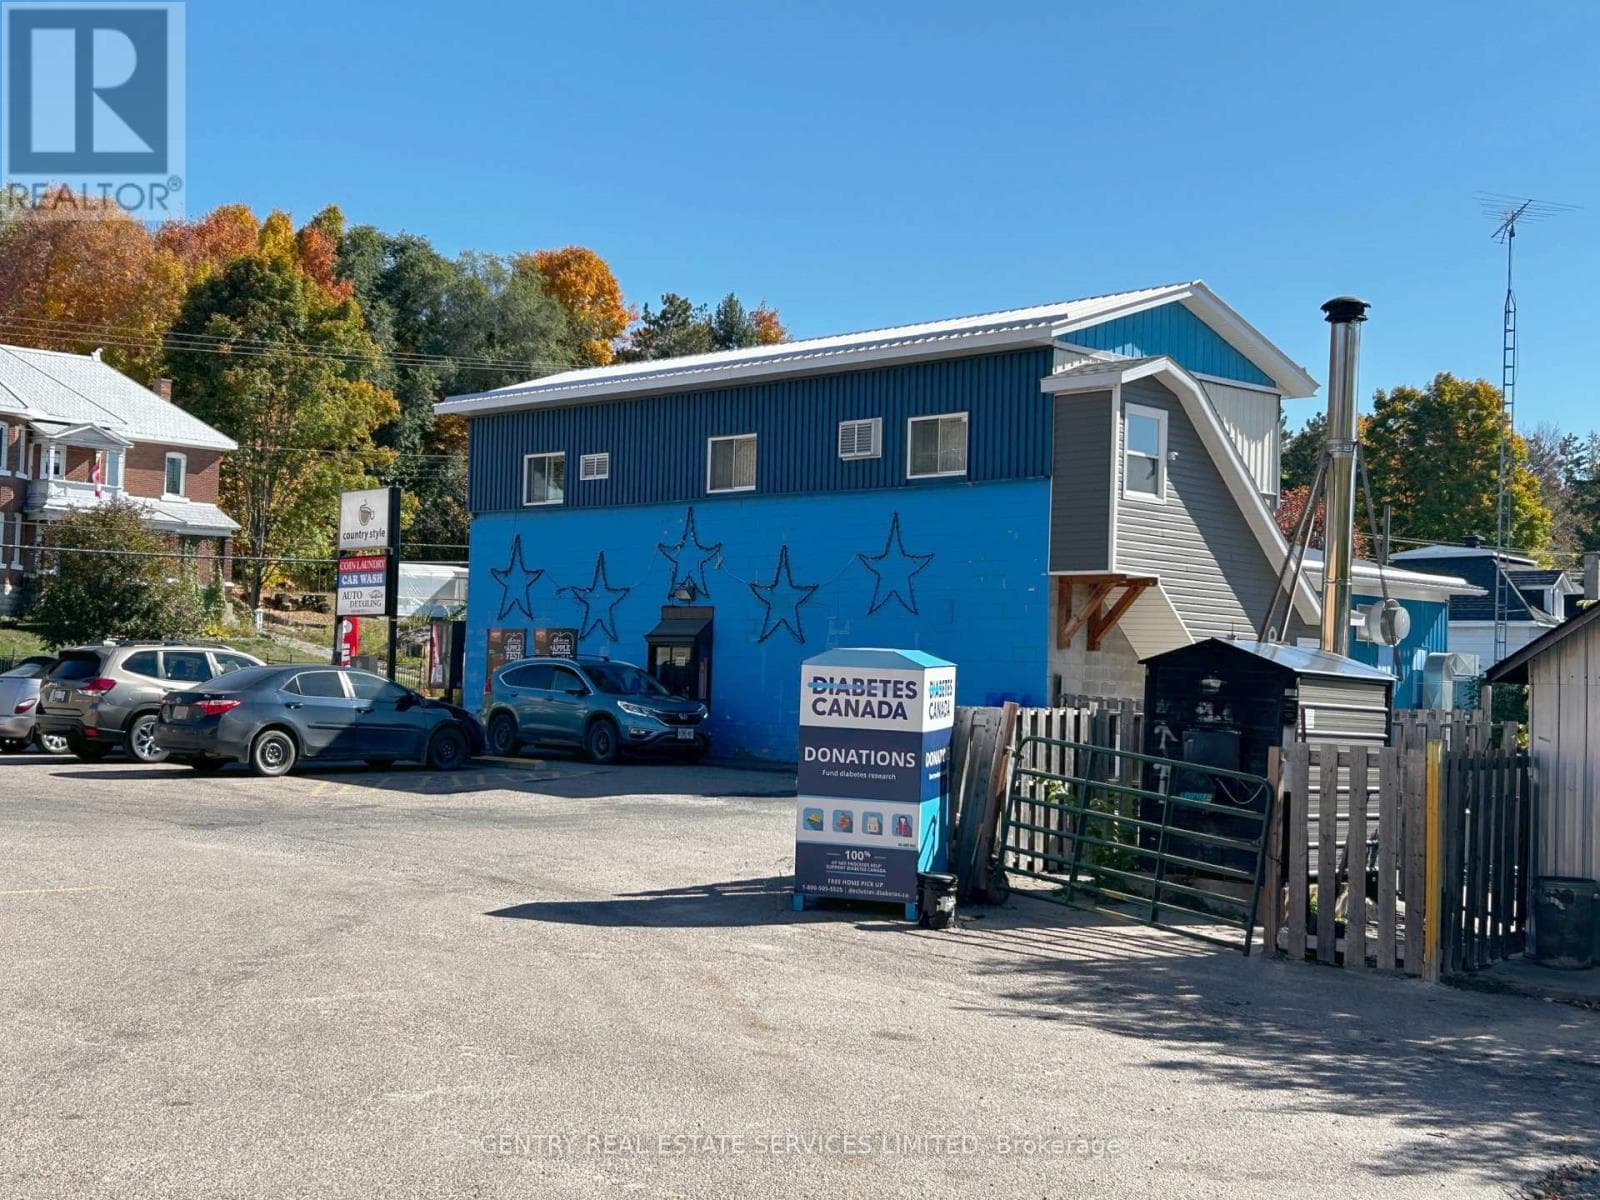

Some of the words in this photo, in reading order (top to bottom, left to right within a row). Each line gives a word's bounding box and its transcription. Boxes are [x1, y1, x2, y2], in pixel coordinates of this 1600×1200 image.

[343, 529, 368, 541] country
[369, 527, 386, 539] style
[340, 560, 355, 570] COIN
[356, 559, 385, 570] LAUNDRY
[341, 574, 358, 585] CAR
[360, 573, 383, 584] WASH
[342, 591, 363, 600] AUTO
[350, 600, 382, 608] DETAILING
[812, 676, 917, 699] DIABETES
[929, 679, 953, 699] DIABETES
[812, 697, 908, 720] CANADA
[929, 700, 951, 720] CANADA
[804, 746, 916, 768] DONATIONS
[822, 769, 839, 777] Fund
[839, 770, 867, 779] diabetes
[868, 772, 896, 781] research
[845, 850, 871, 861] 100%
[842, 879, 860, 887] HOME
[861, 880, 874, 888] PICK
